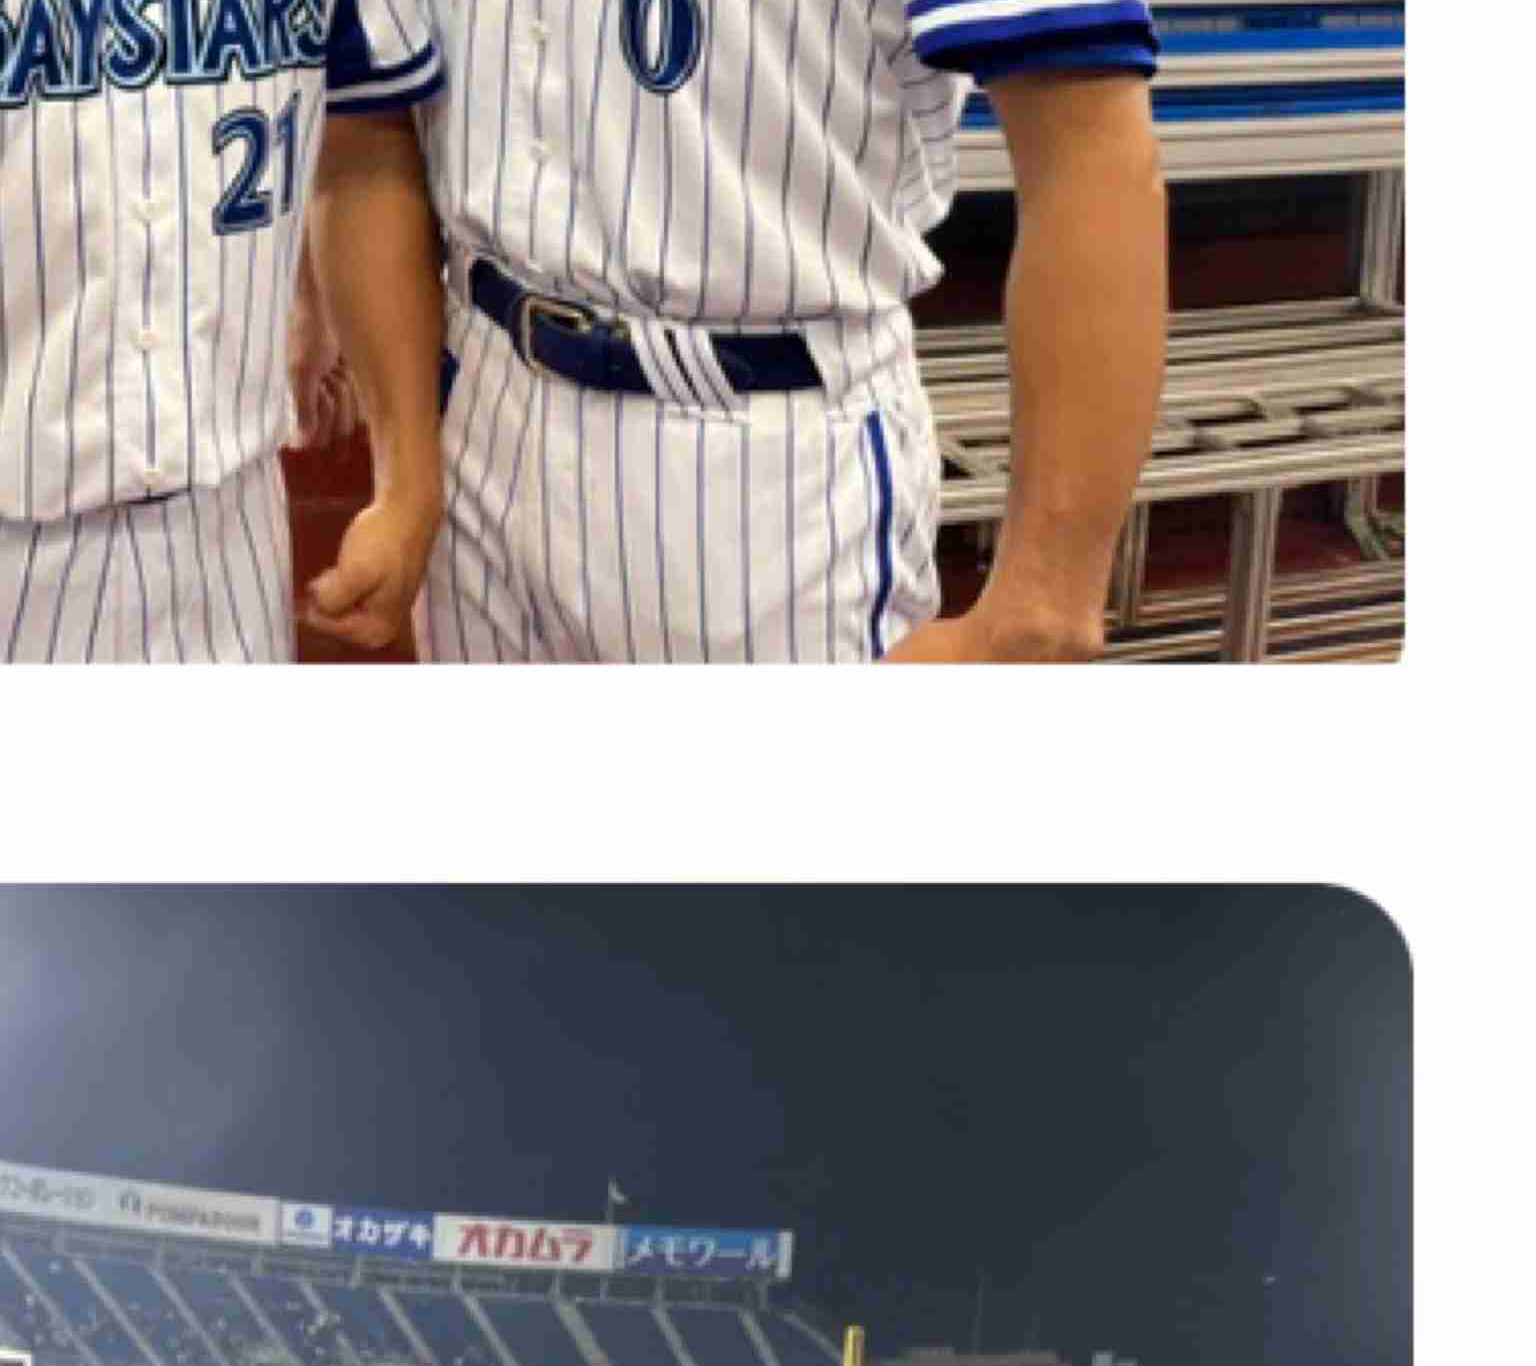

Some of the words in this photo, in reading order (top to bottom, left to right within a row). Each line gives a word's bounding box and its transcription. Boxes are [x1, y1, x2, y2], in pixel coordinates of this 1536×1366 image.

[211, 91, 302, 237] 21
[457, 1222, 595, 1263] オカムラ
[627, 1234, 778, 1272] メモワール
